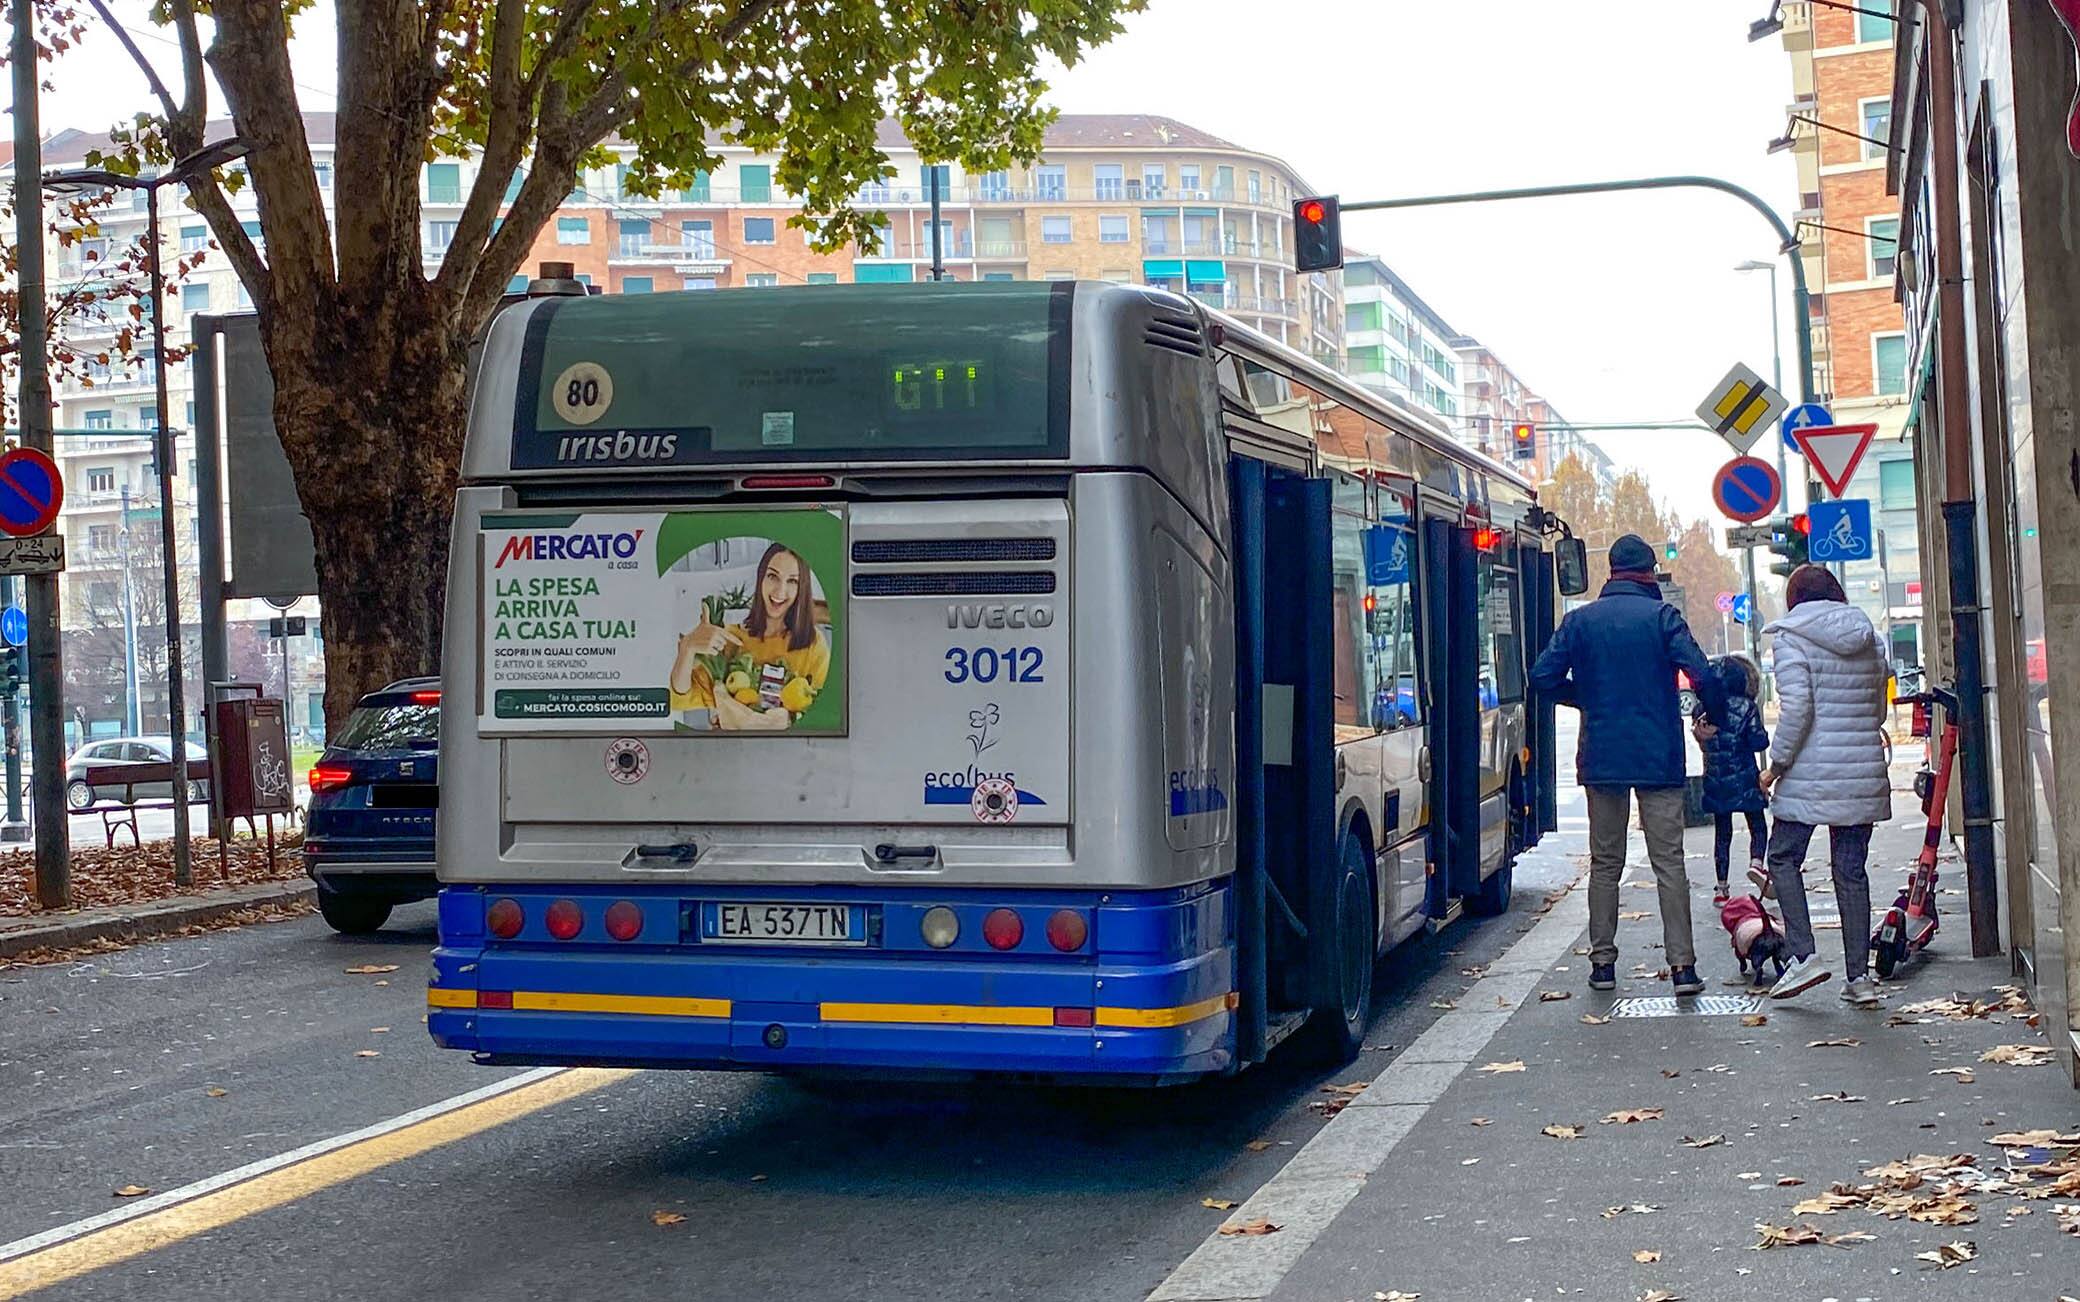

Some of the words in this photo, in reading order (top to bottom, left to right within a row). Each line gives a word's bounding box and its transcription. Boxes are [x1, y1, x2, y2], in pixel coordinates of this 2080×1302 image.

[567, 380, 599, 406] 80
[558, 430, 678, 461] irisbus
[608, 561, 614, 569] a
[616, 561, 638, 569] casa
[495, 578, 523, 597] LA
[528, 577, 600, 596] SPESA
[494, 599, 580, 618] ARRIVA
[946, 604, 1054, 629] IVECO
[495, 622, 511, 640] A
[517, 621, 579, 640] CASA
[583, 620, 636, 639] TUA!
[494, 648, 529, 657] SCOPRI
[532, 648, 542, 656] IN
[544, 648, 573, 657] QUALI
[575, 647, 616, 656] COMUNI
[502, 659, 535, 669] ATTIVO
[547, 658, 587, 668] SERVIZIO
[944, 646, 1044, 683] 3012
[495, 672, 504, 681] DI
[506, 671, 559, 681] CONSEGNA
[560, 671, 568, 680] A
[570, 671, 621, 680] DOMICILIO
[523, 702, 666, 713] MERCATO.COSICOMODO.IT
[571, 695, 597, 703] spesa
[598, 693, 626, 701] online
[721, 906, 752, 935] EA
[764, 907, 846, 936] 537TN
